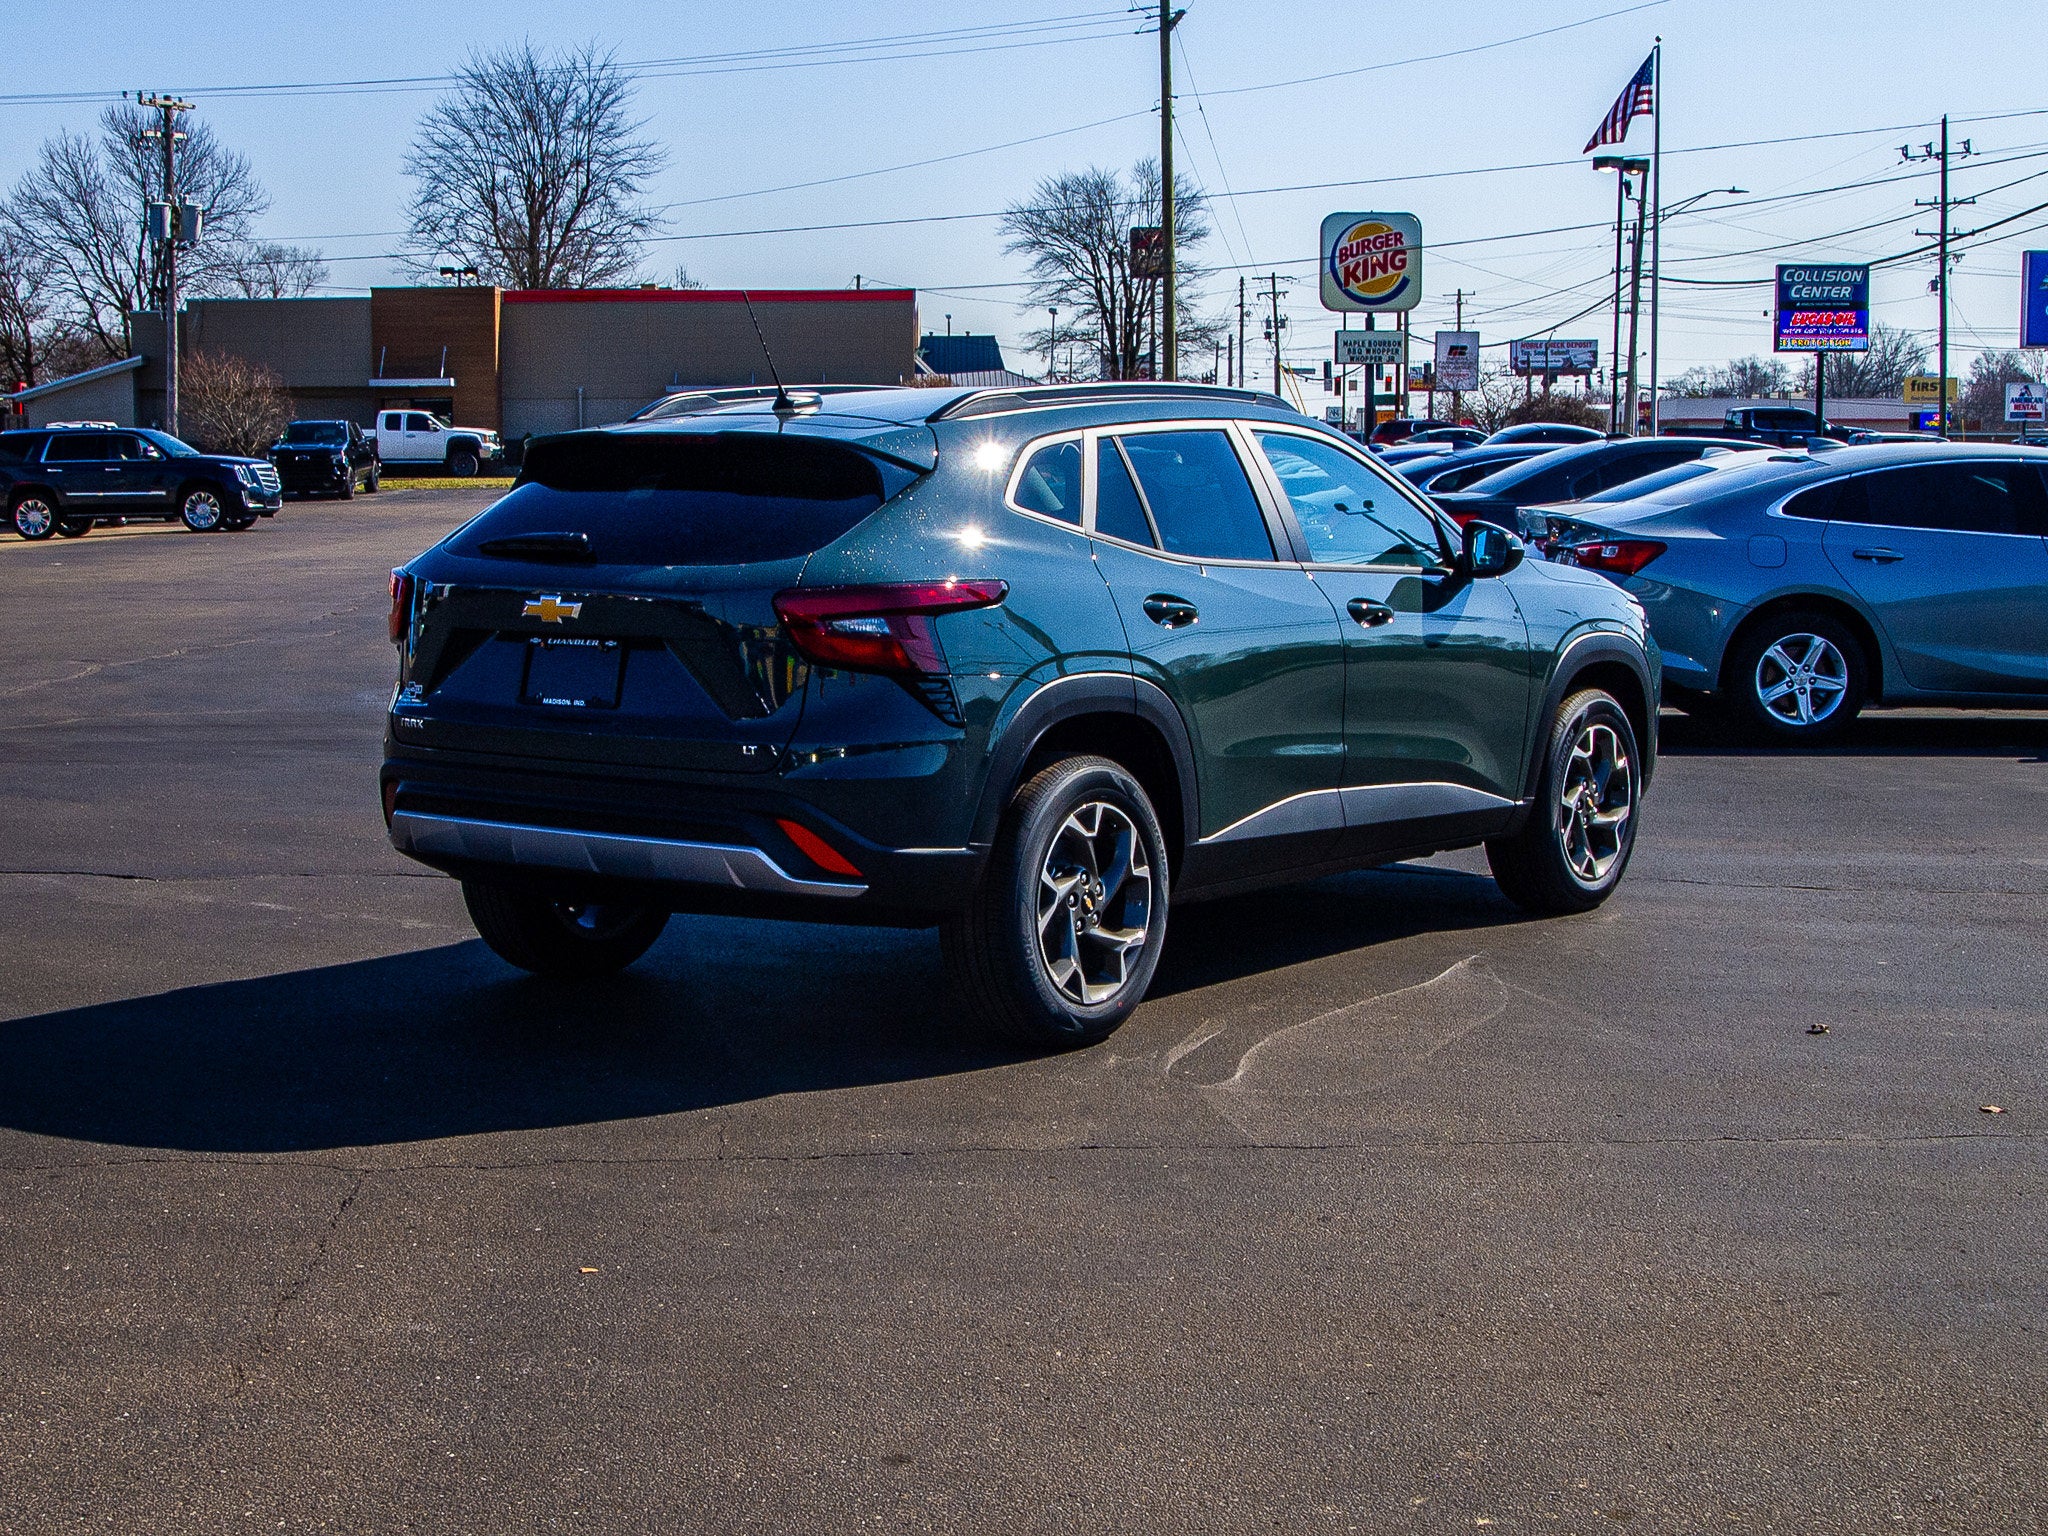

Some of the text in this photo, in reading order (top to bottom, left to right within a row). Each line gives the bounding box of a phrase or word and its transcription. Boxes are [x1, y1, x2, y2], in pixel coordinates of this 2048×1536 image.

[1339, 231, 1404, 265] BURGER
[1343, 249, 1408, 289] KING
[1783, 269, 1863, 282] COLLISION
[1791, 285, 1852, 298] CENTER
[1790, 312, 1834, 326] LUCAS
[2010, 396, 2044, 404] AMERICAN
[2013, 403, 2039, 411] RENTAL
[547, 638, 599, 646] CHANDLER
[742, 745, 758, 755] LT
